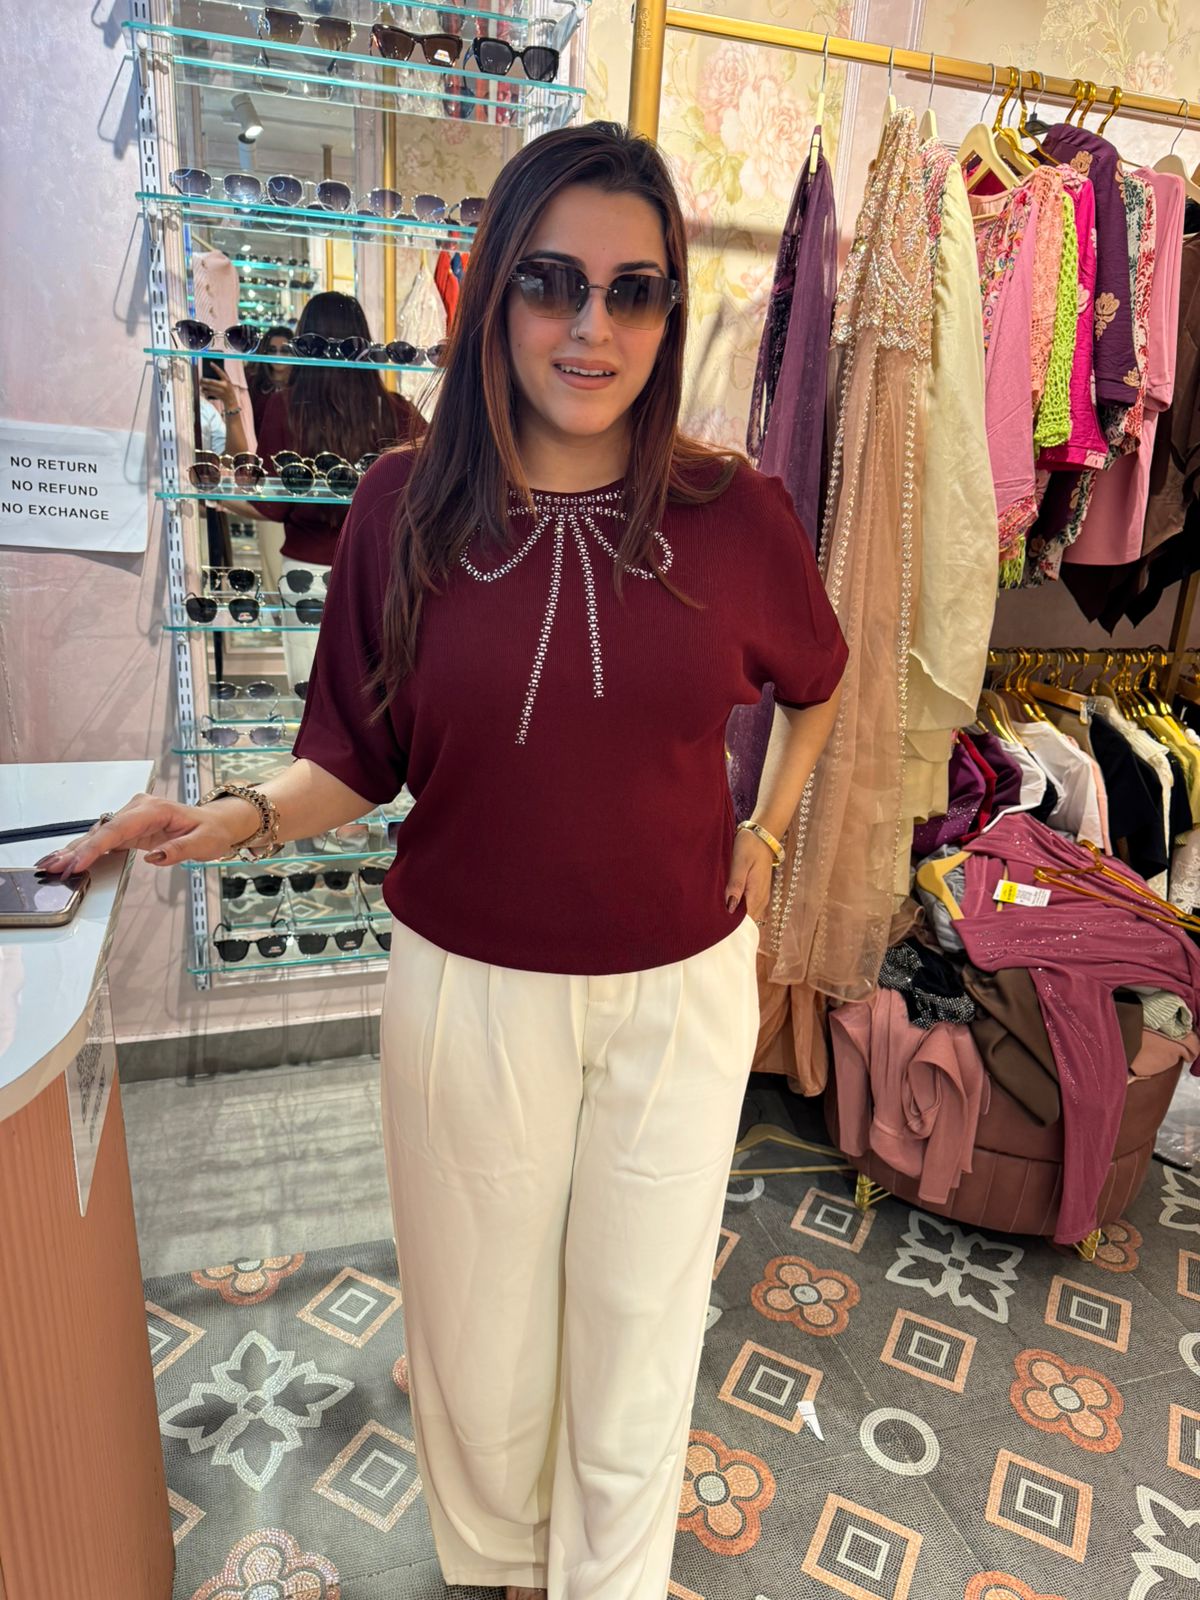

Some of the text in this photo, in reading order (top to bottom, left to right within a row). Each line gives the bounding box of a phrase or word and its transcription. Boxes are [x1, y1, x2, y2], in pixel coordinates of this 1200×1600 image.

[10, 456, 97, 473] NO RETURN
[11, 480, 98, 496] NO REFUND
[2, 502, 109, 520] NO EXCHANGE
